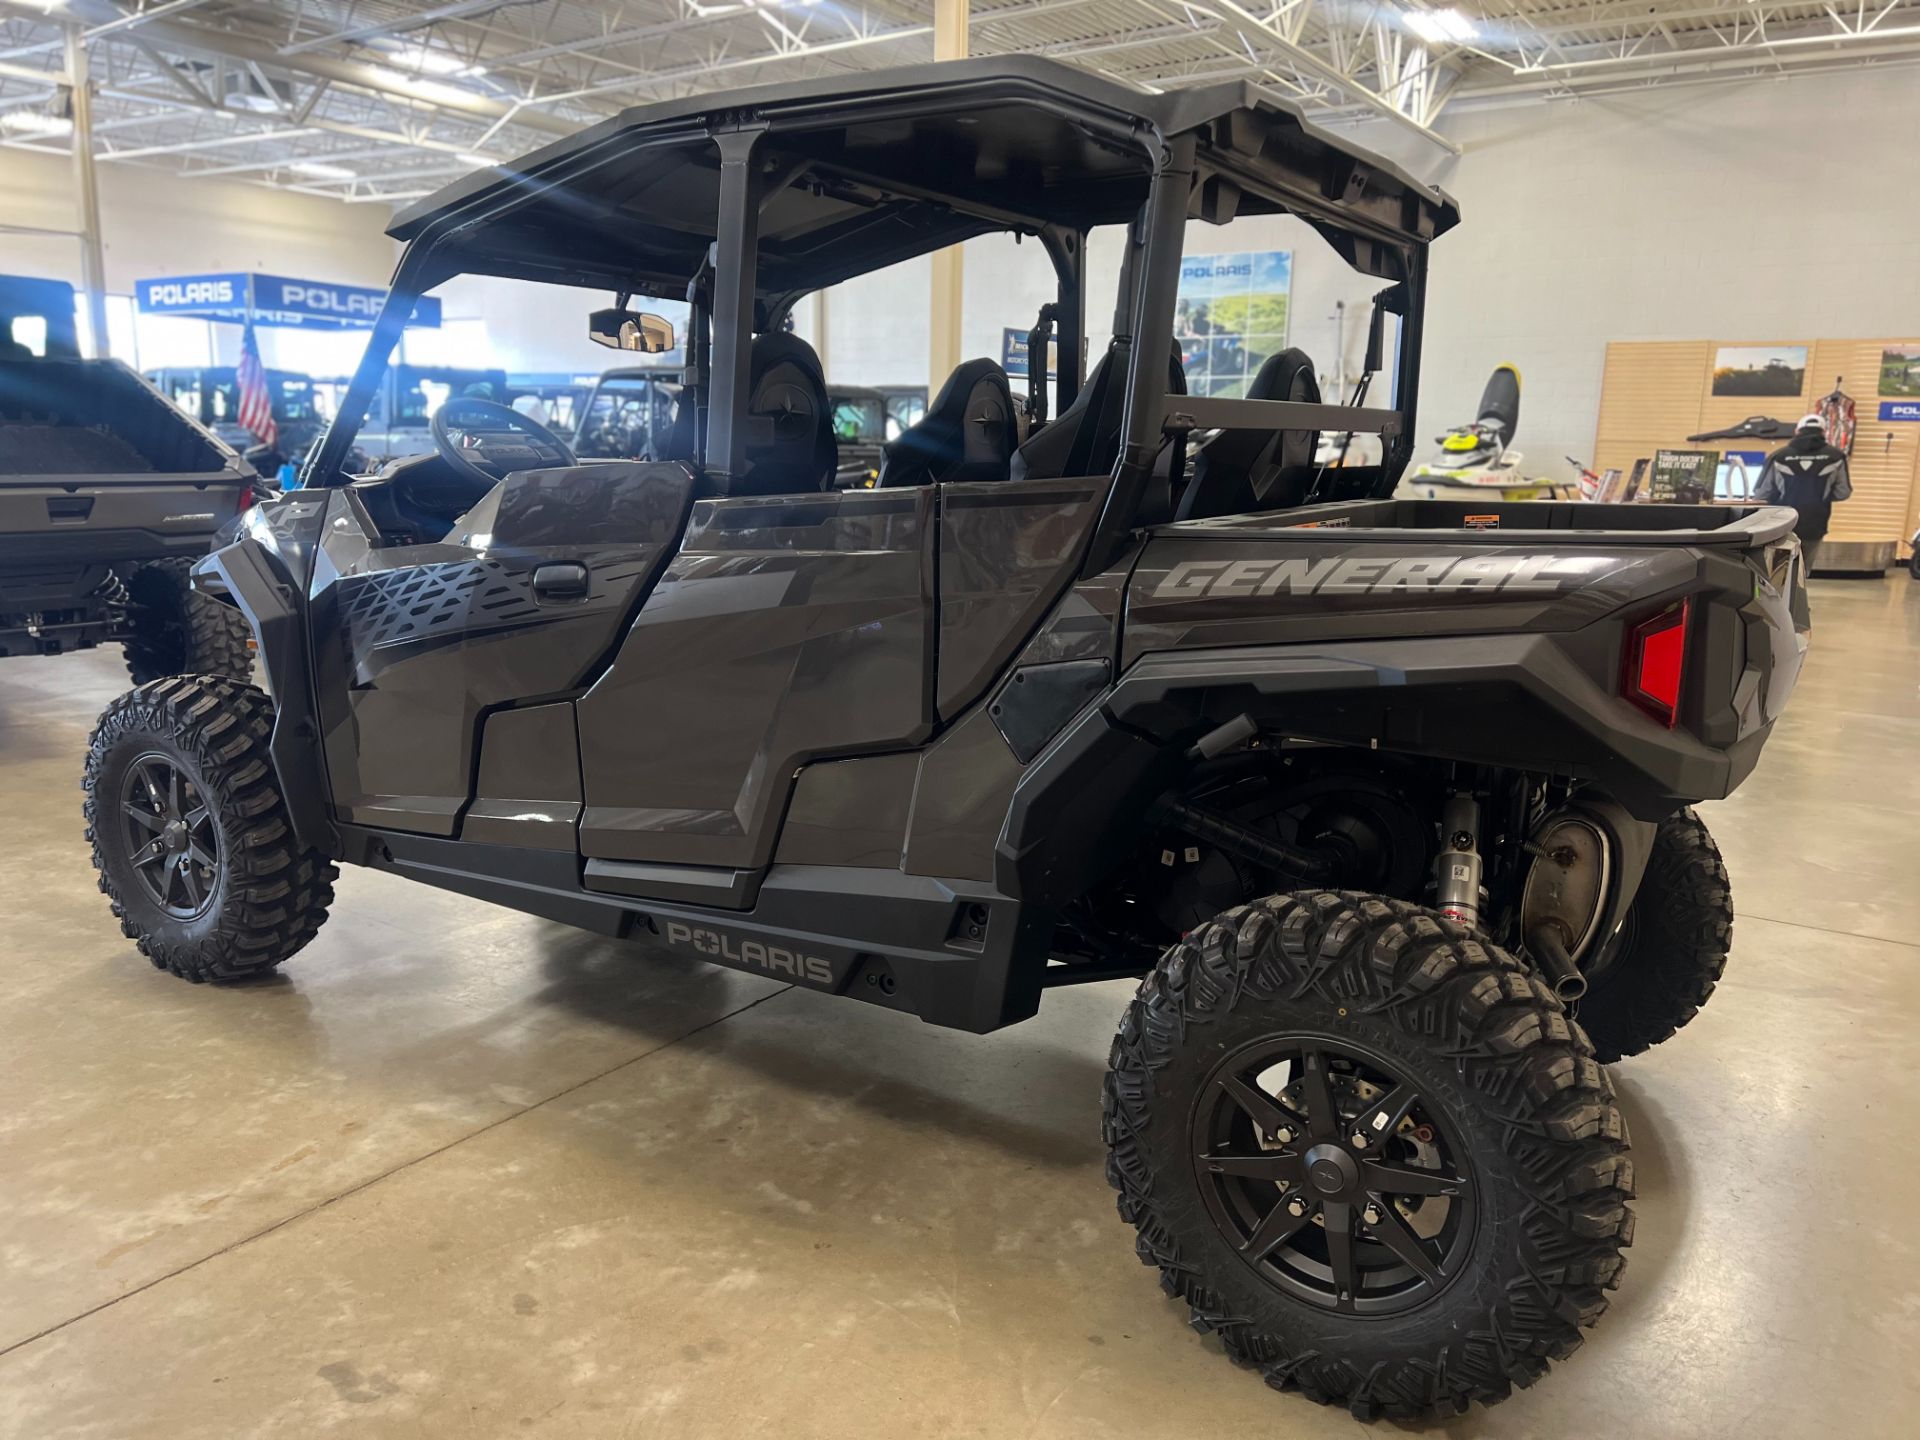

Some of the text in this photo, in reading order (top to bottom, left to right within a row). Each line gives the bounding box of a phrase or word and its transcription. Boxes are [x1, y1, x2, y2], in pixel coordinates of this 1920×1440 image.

[1183, 264, 1252, 278] POLARIS
[149, 281, 233, 306] POLARIS
[281, 285, 418, 321] POLAR
[1152, 554, 1568, 597] GENERAL
[667, 922, 833, 984] POLARIS
